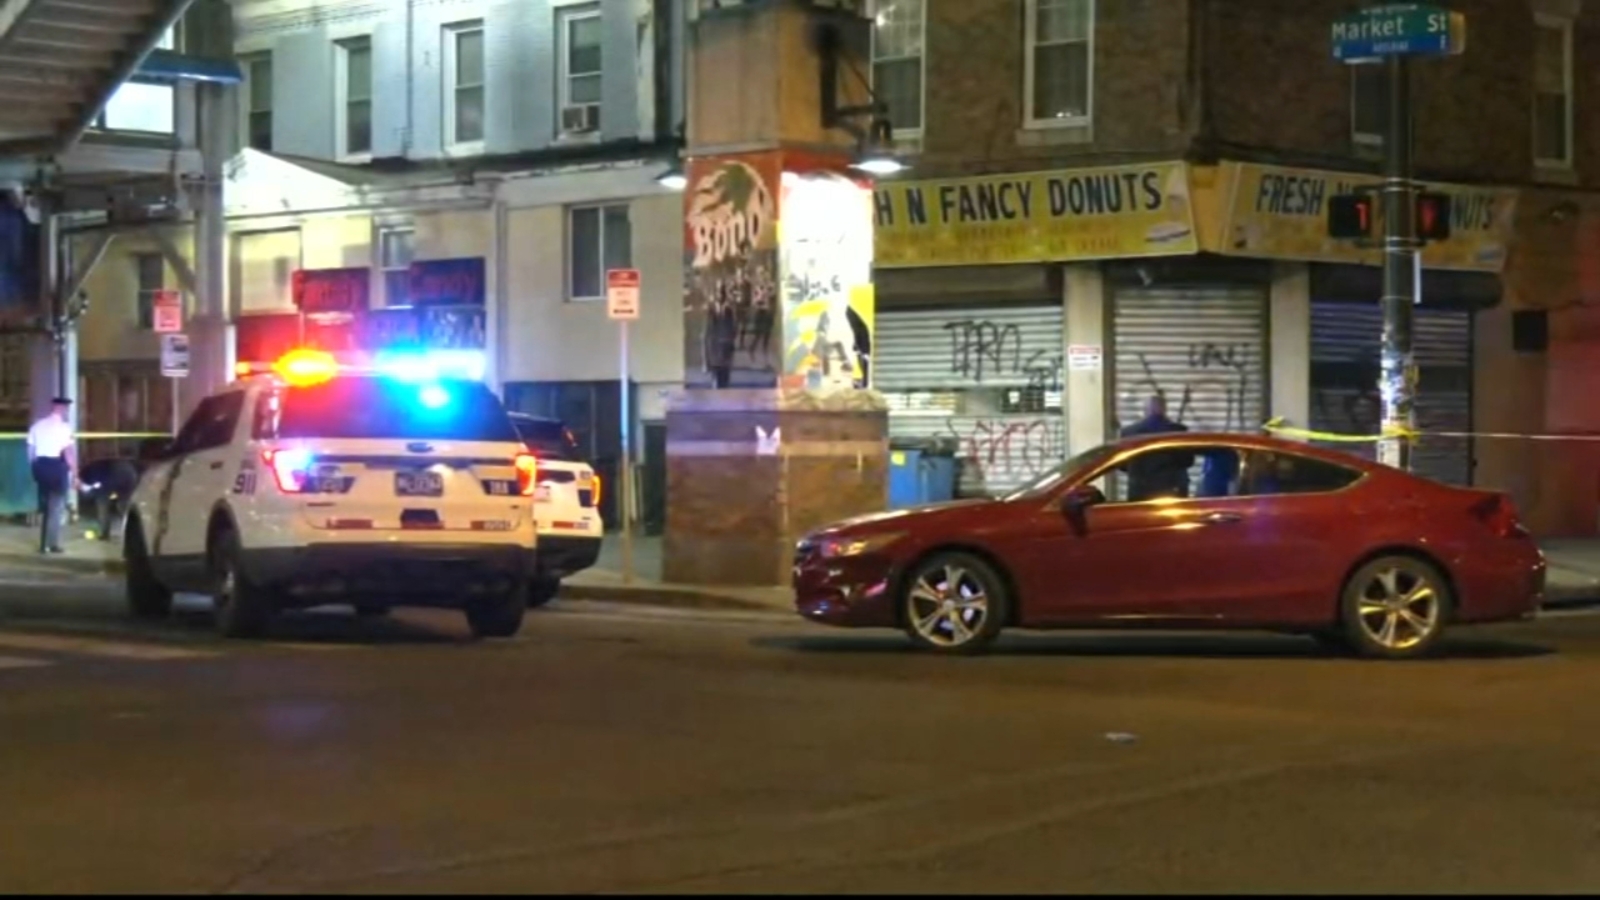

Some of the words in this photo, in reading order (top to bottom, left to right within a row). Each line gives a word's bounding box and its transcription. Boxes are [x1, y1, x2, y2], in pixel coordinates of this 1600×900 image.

[1331, 15, 1405, 40] Market
[1427, 12, 1446, 32] St
[906, 186, 927, 225] N
[939, 178, 1032, 224] FANCY
[1048, 171, 1163, 217] DONUTS
[1256, 173, 1326, 217] FRESH
[232, 471, 258, 495] 911
